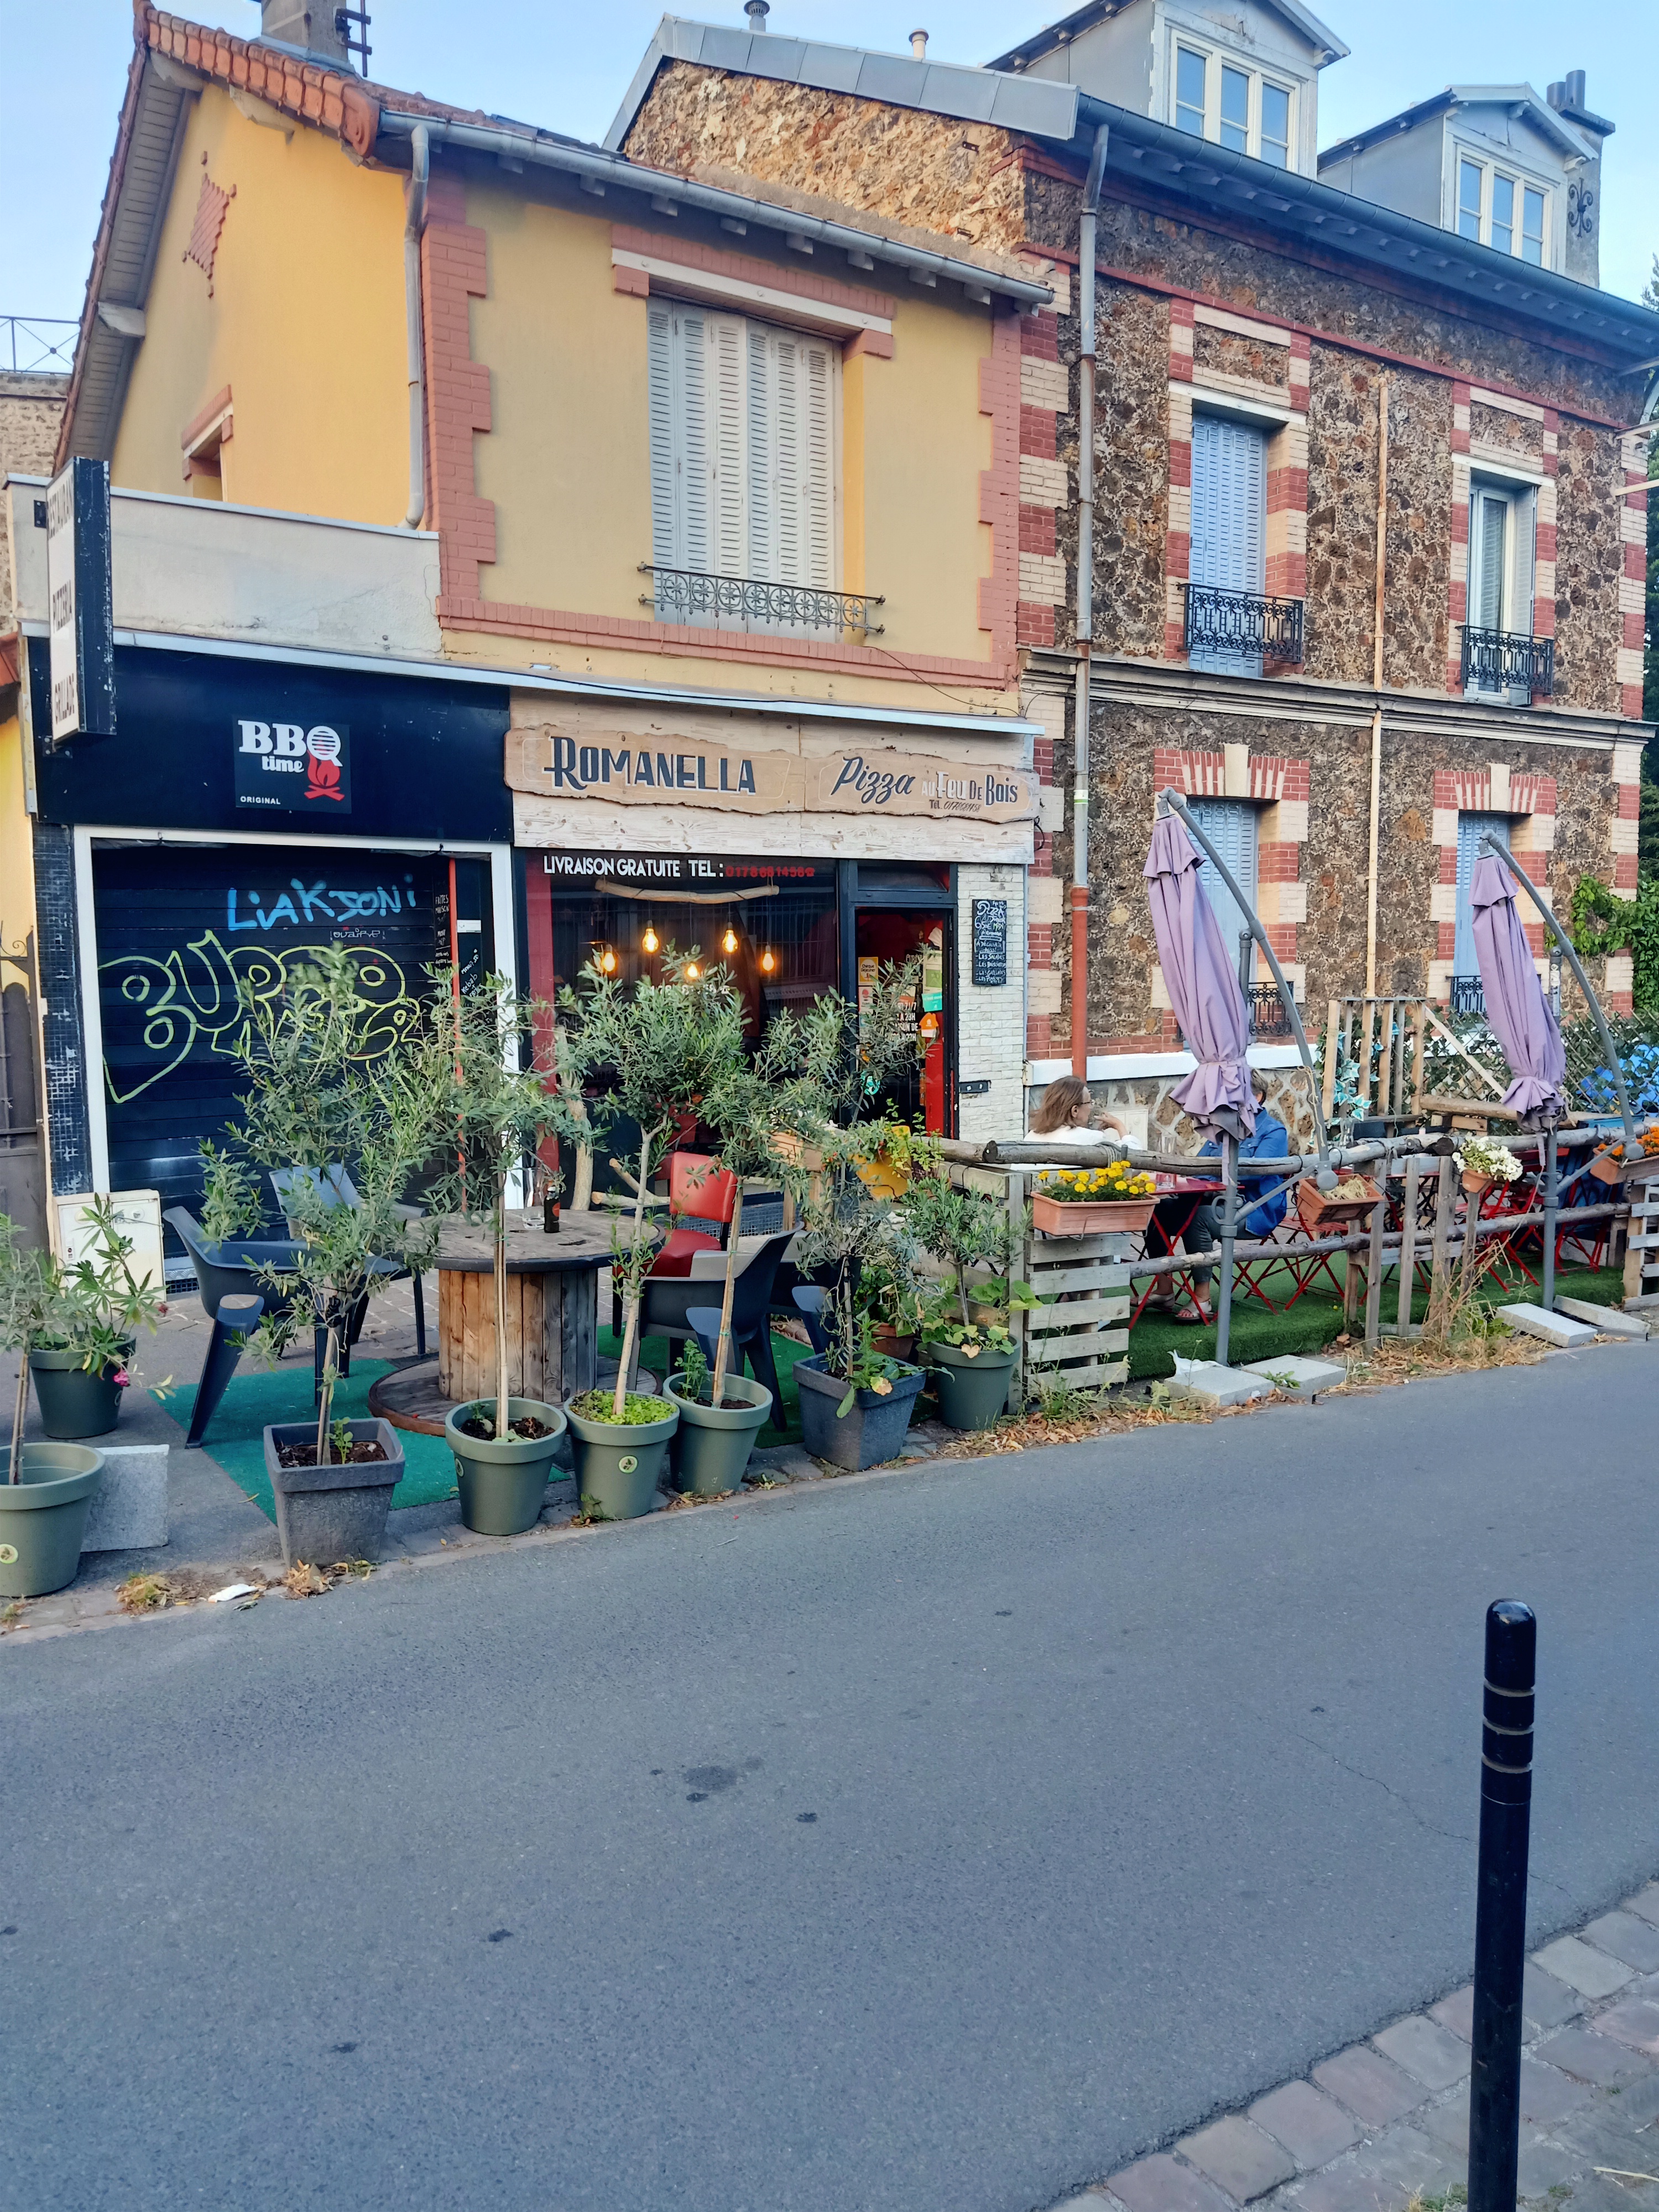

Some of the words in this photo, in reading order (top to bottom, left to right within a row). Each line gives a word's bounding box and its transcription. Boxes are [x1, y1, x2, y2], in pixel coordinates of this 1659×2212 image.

[238, 719, 343, 767] BBQ
[262, 755, 304, 773] time
[542, 735, 756, 795] ROMANELLA
[829, 756, 916, 804] Pizza
[921, 781, 935, 796] AU
[969, 780, 982, 800] DE
[984, 775, 1018, 806] Bois
[240, 796, 281, 805] ORIGINAL
[543, 855, 614, 875] LIVRAISON
[617, 858, 680, 877] GRATUITE
[911, 1022, 918, 1031] DE
